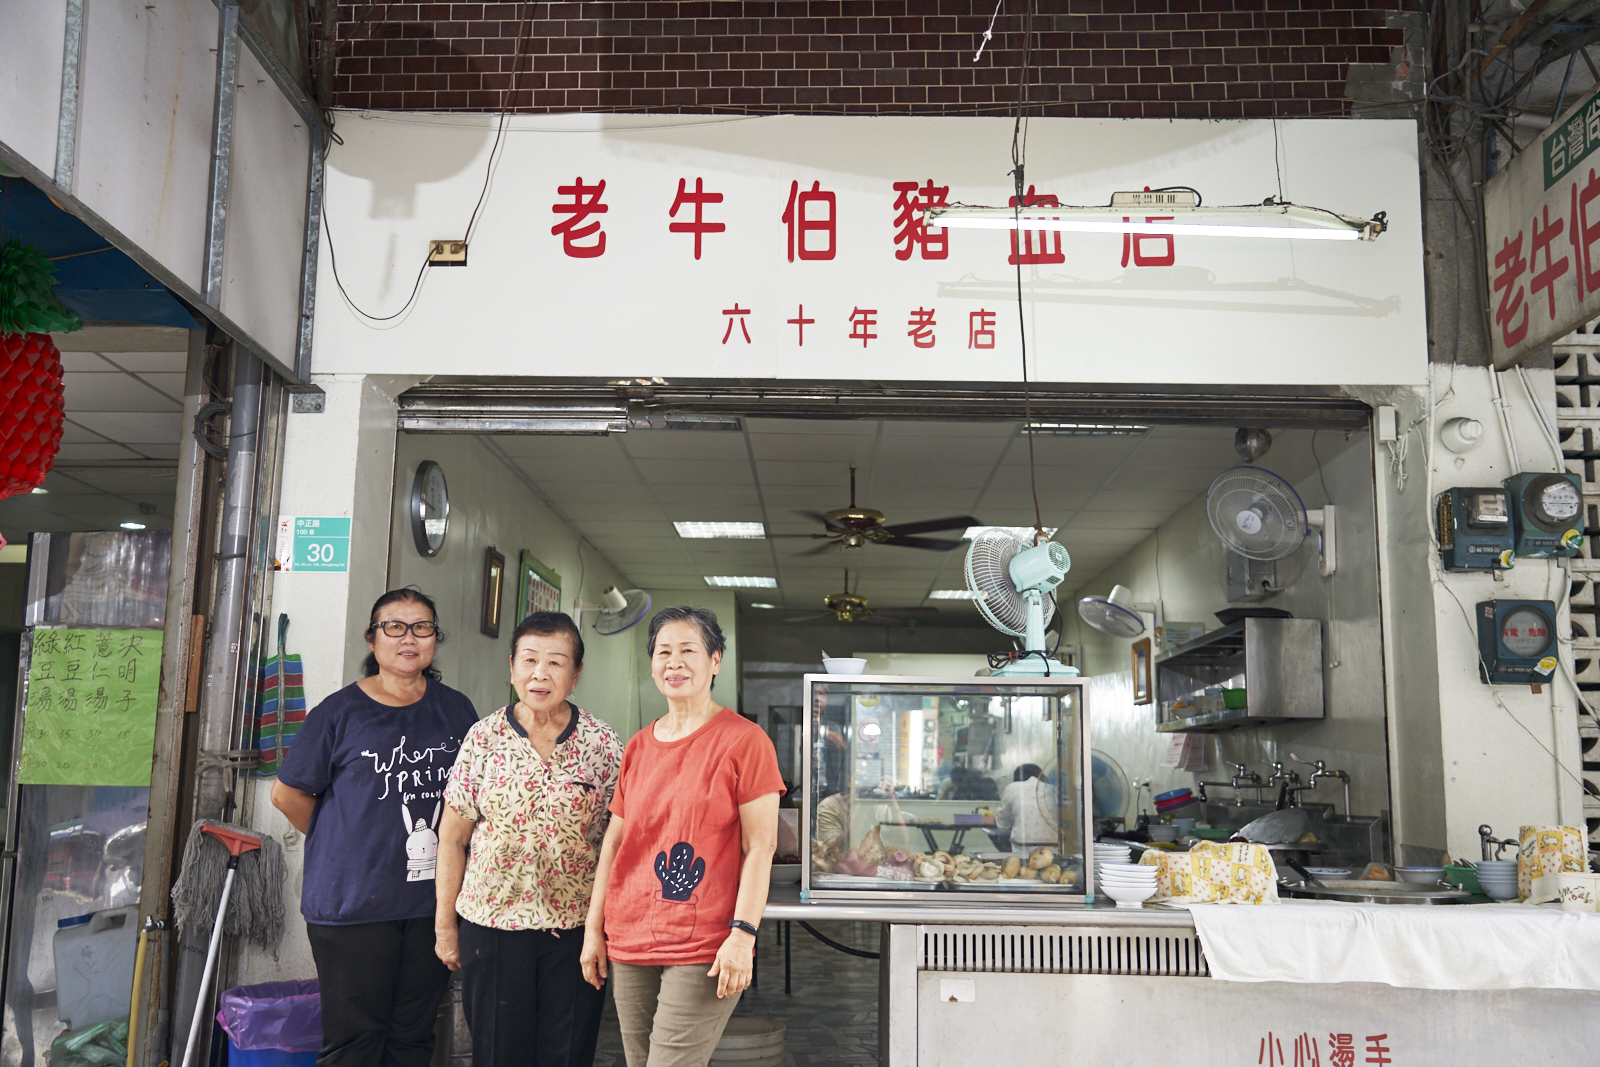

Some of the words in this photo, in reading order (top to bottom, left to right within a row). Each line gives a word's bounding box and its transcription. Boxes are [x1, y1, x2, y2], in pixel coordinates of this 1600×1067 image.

[721, 302, 997, 349] 六十年老店
[296, 519, 320, 528] 中正路
[306, 543, 335, 563] 30
[38, 729, 50, 740] 30
[58, 729, 74, 739] 35
[86, 729, 101, 740] 30
[117, 730, 131, 739] 15
[360, 735, 462, 774] Where'
[35, 760, 47, 768] 20
[56, 761, 70, 769] 20
